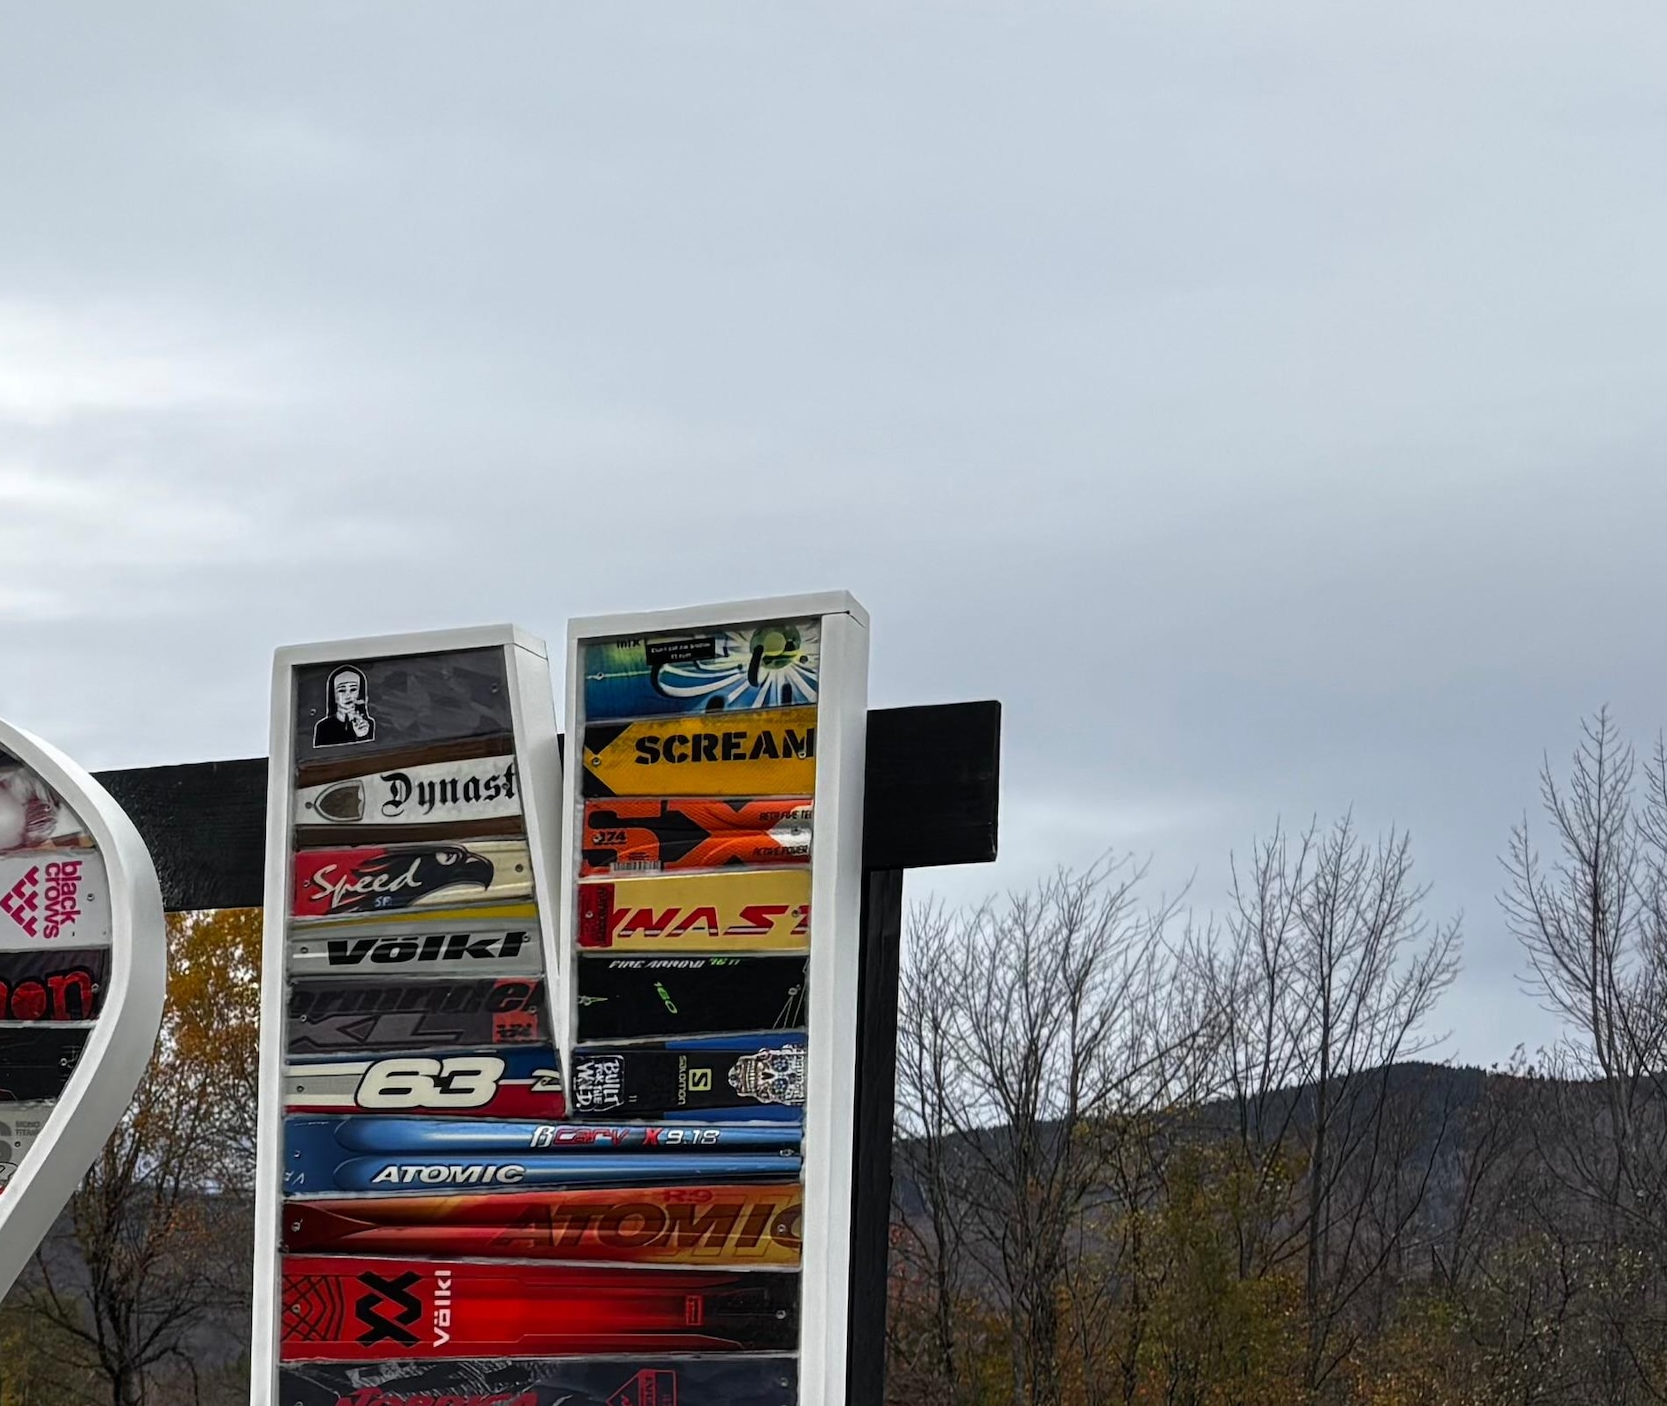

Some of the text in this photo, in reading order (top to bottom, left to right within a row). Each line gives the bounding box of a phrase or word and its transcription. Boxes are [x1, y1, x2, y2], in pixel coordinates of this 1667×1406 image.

[633, 728, 815, 767] SCREAM
[60, 860, 83, 926] black
[310, 850, 424, 902] Speed
[42, 861, 61, 940] crows
[326, 929, 528, 966] Völkl
[608, 959, 644, 970] FIRE
[646, 959, 705, 970] ARROW
[356, 1057, 506, 1109] 63
[665, 1127, 721, 1146] 9.18
[369, 1164, 527, 1185] ATOMIC
